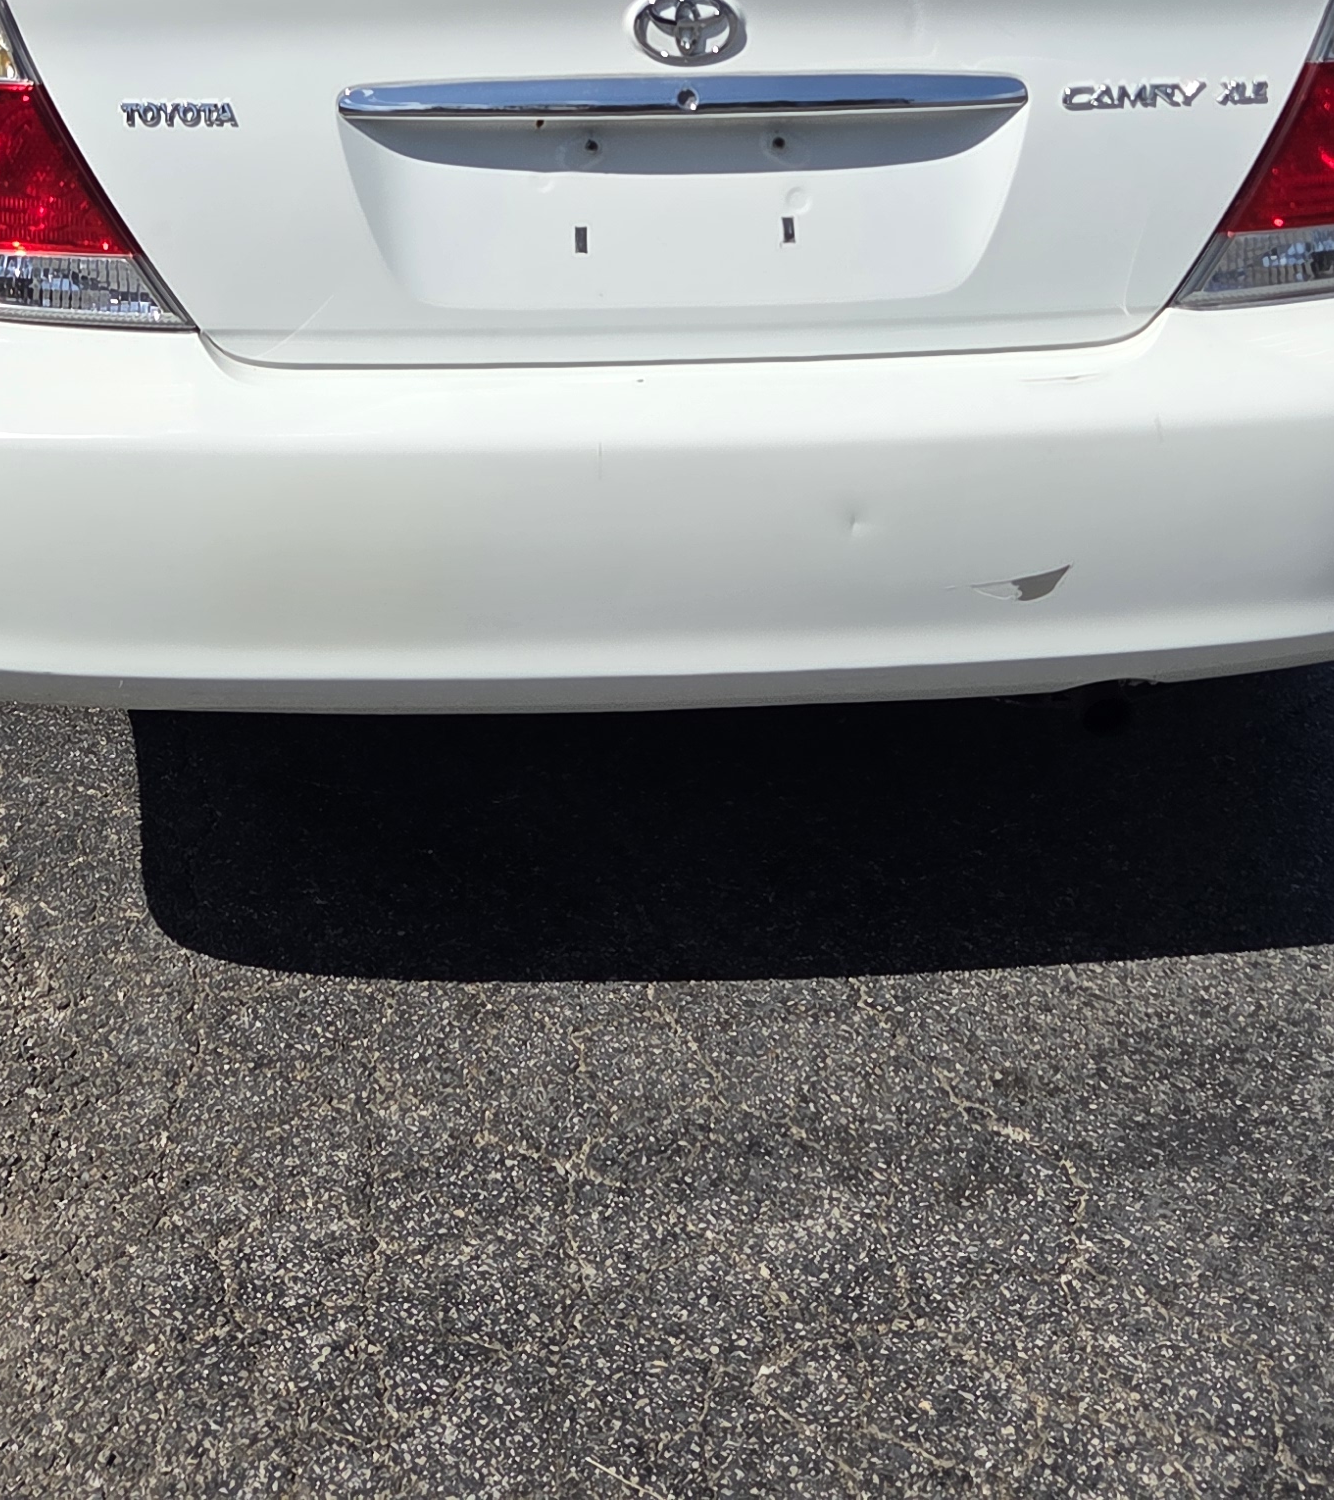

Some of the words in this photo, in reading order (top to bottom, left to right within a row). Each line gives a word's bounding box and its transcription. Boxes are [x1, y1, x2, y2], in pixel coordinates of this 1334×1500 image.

[1062, 81, 1207, 111] CAMRY
[1215, 80, 1268, 106] XLE
[120, 100, 239, 128] TOYOTA
